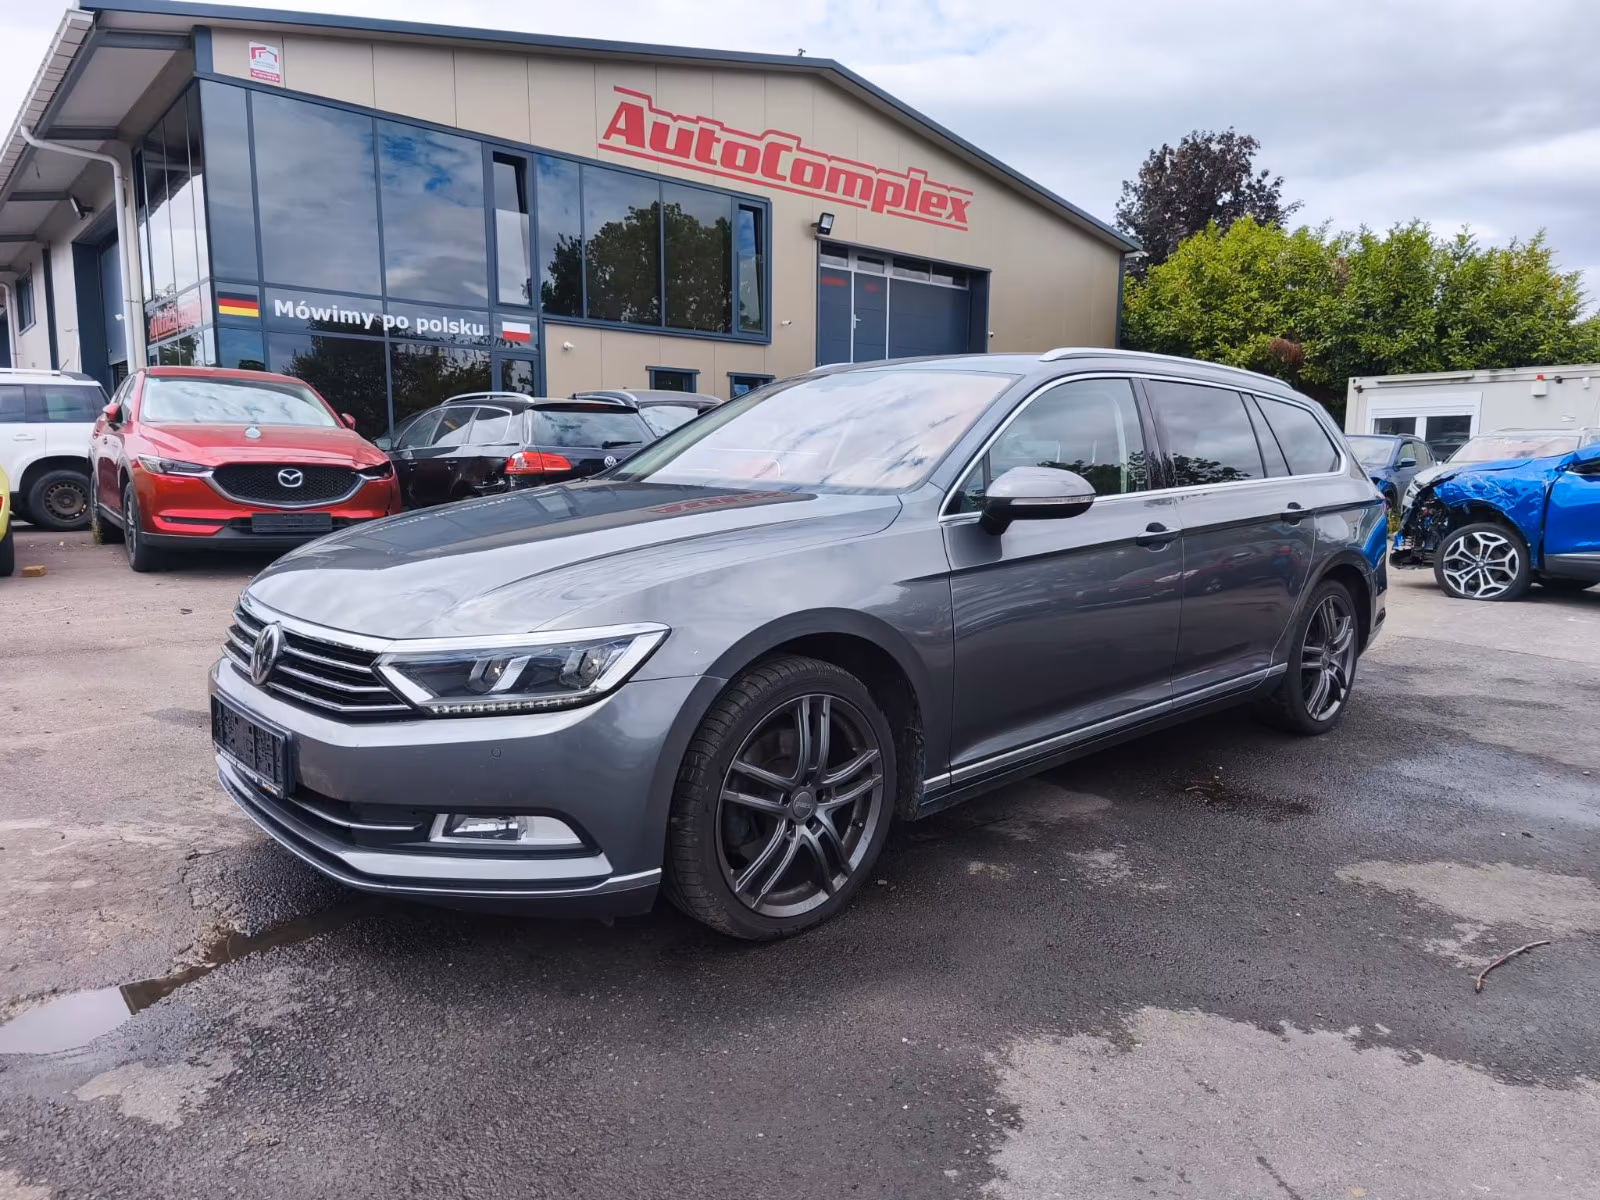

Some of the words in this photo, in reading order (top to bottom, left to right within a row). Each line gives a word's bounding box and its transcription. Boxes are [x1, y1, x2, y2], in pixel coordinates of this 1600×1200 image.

[602, 100, 972, 224] AutoComplex
[274, 299, 375, 330] Mówimy
[383, 313, 409, 331] po
[417, 317, 484, 336] polsku
